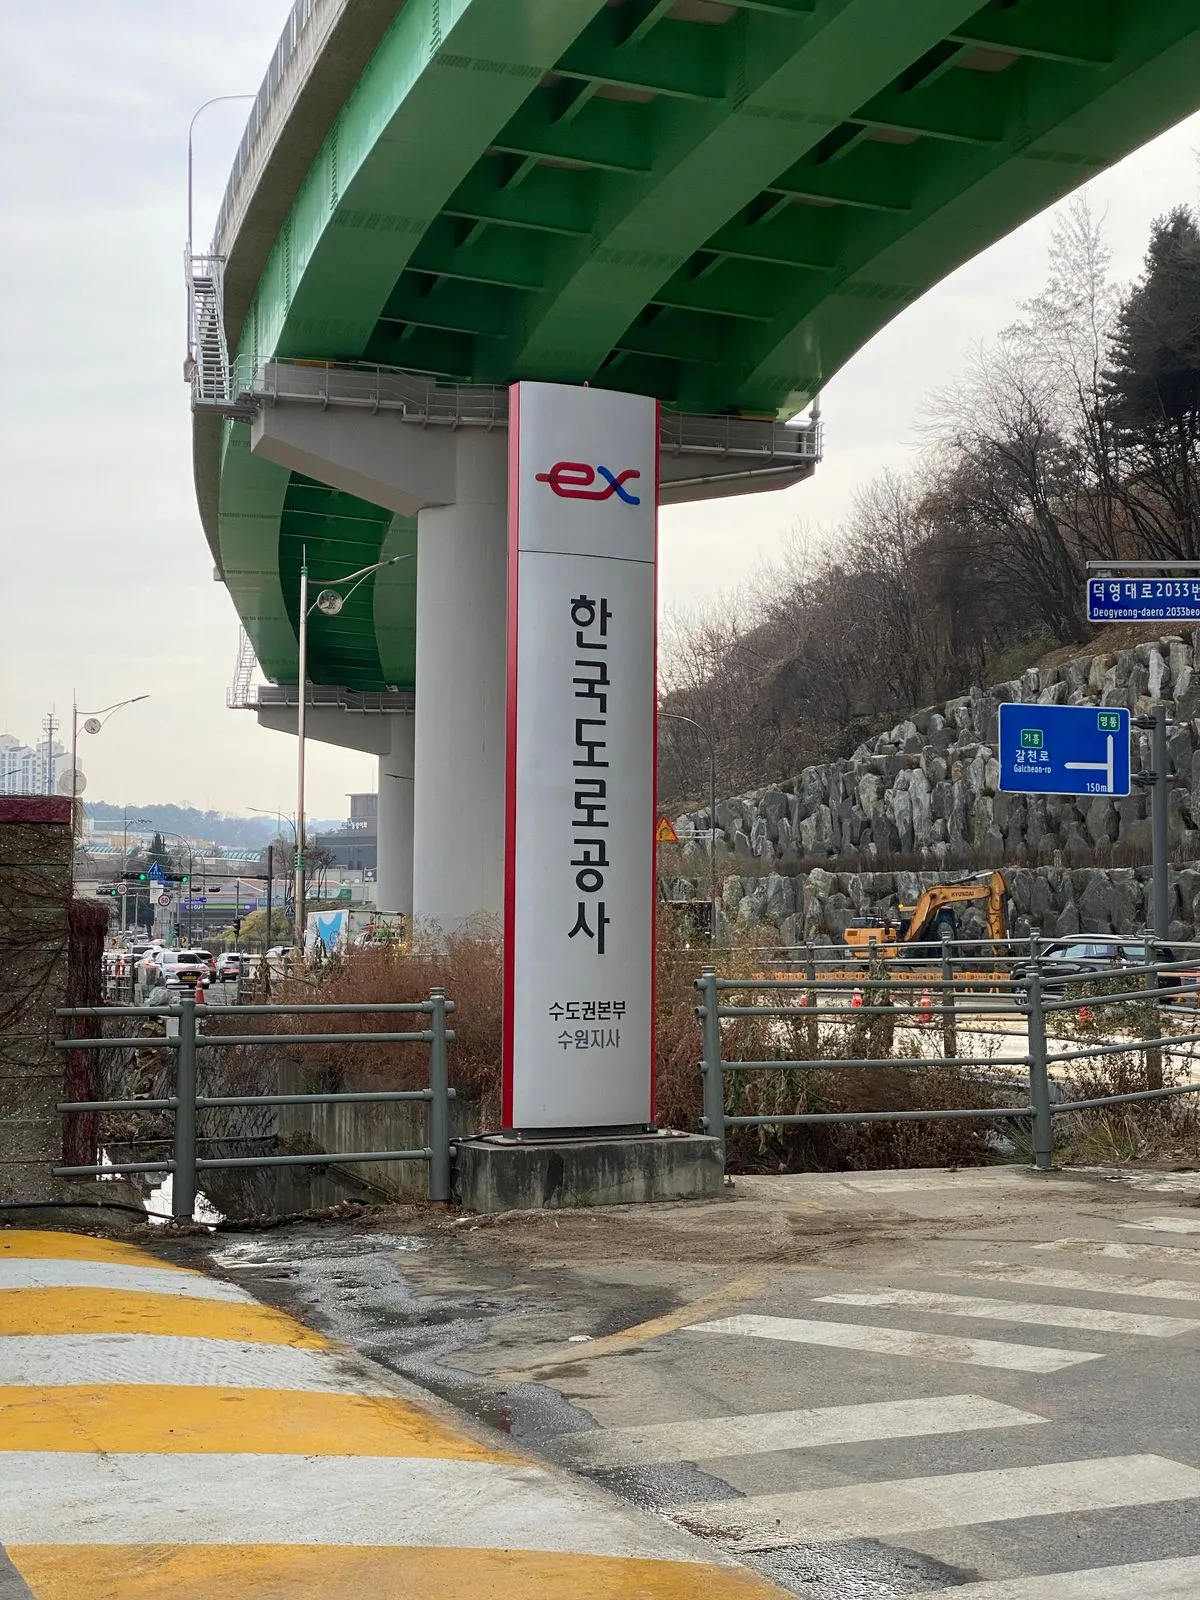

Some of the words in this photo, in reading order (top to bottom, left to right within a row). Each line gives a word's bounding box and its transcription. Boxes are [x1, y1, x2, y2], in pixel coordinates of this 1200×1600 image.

[535, 462, 641, 505] ex
[1093, 607, 1164, 619] Deogyeong-daero
[1099, 716, 1118, 728] 영통
[1023, 733, 1041, 745] 기흥
[1015, 749, 1050, 763] 갈천로
[567, 594, 613, 955] 한국도로공사
[1013, 764, 1052, 774] Galcheon-ro
[1086, 782, 1107, 793] 150m
[549, 1001, 627, 1021] 수도권본부
[558, 1029, 621, 1050] 수원지사
